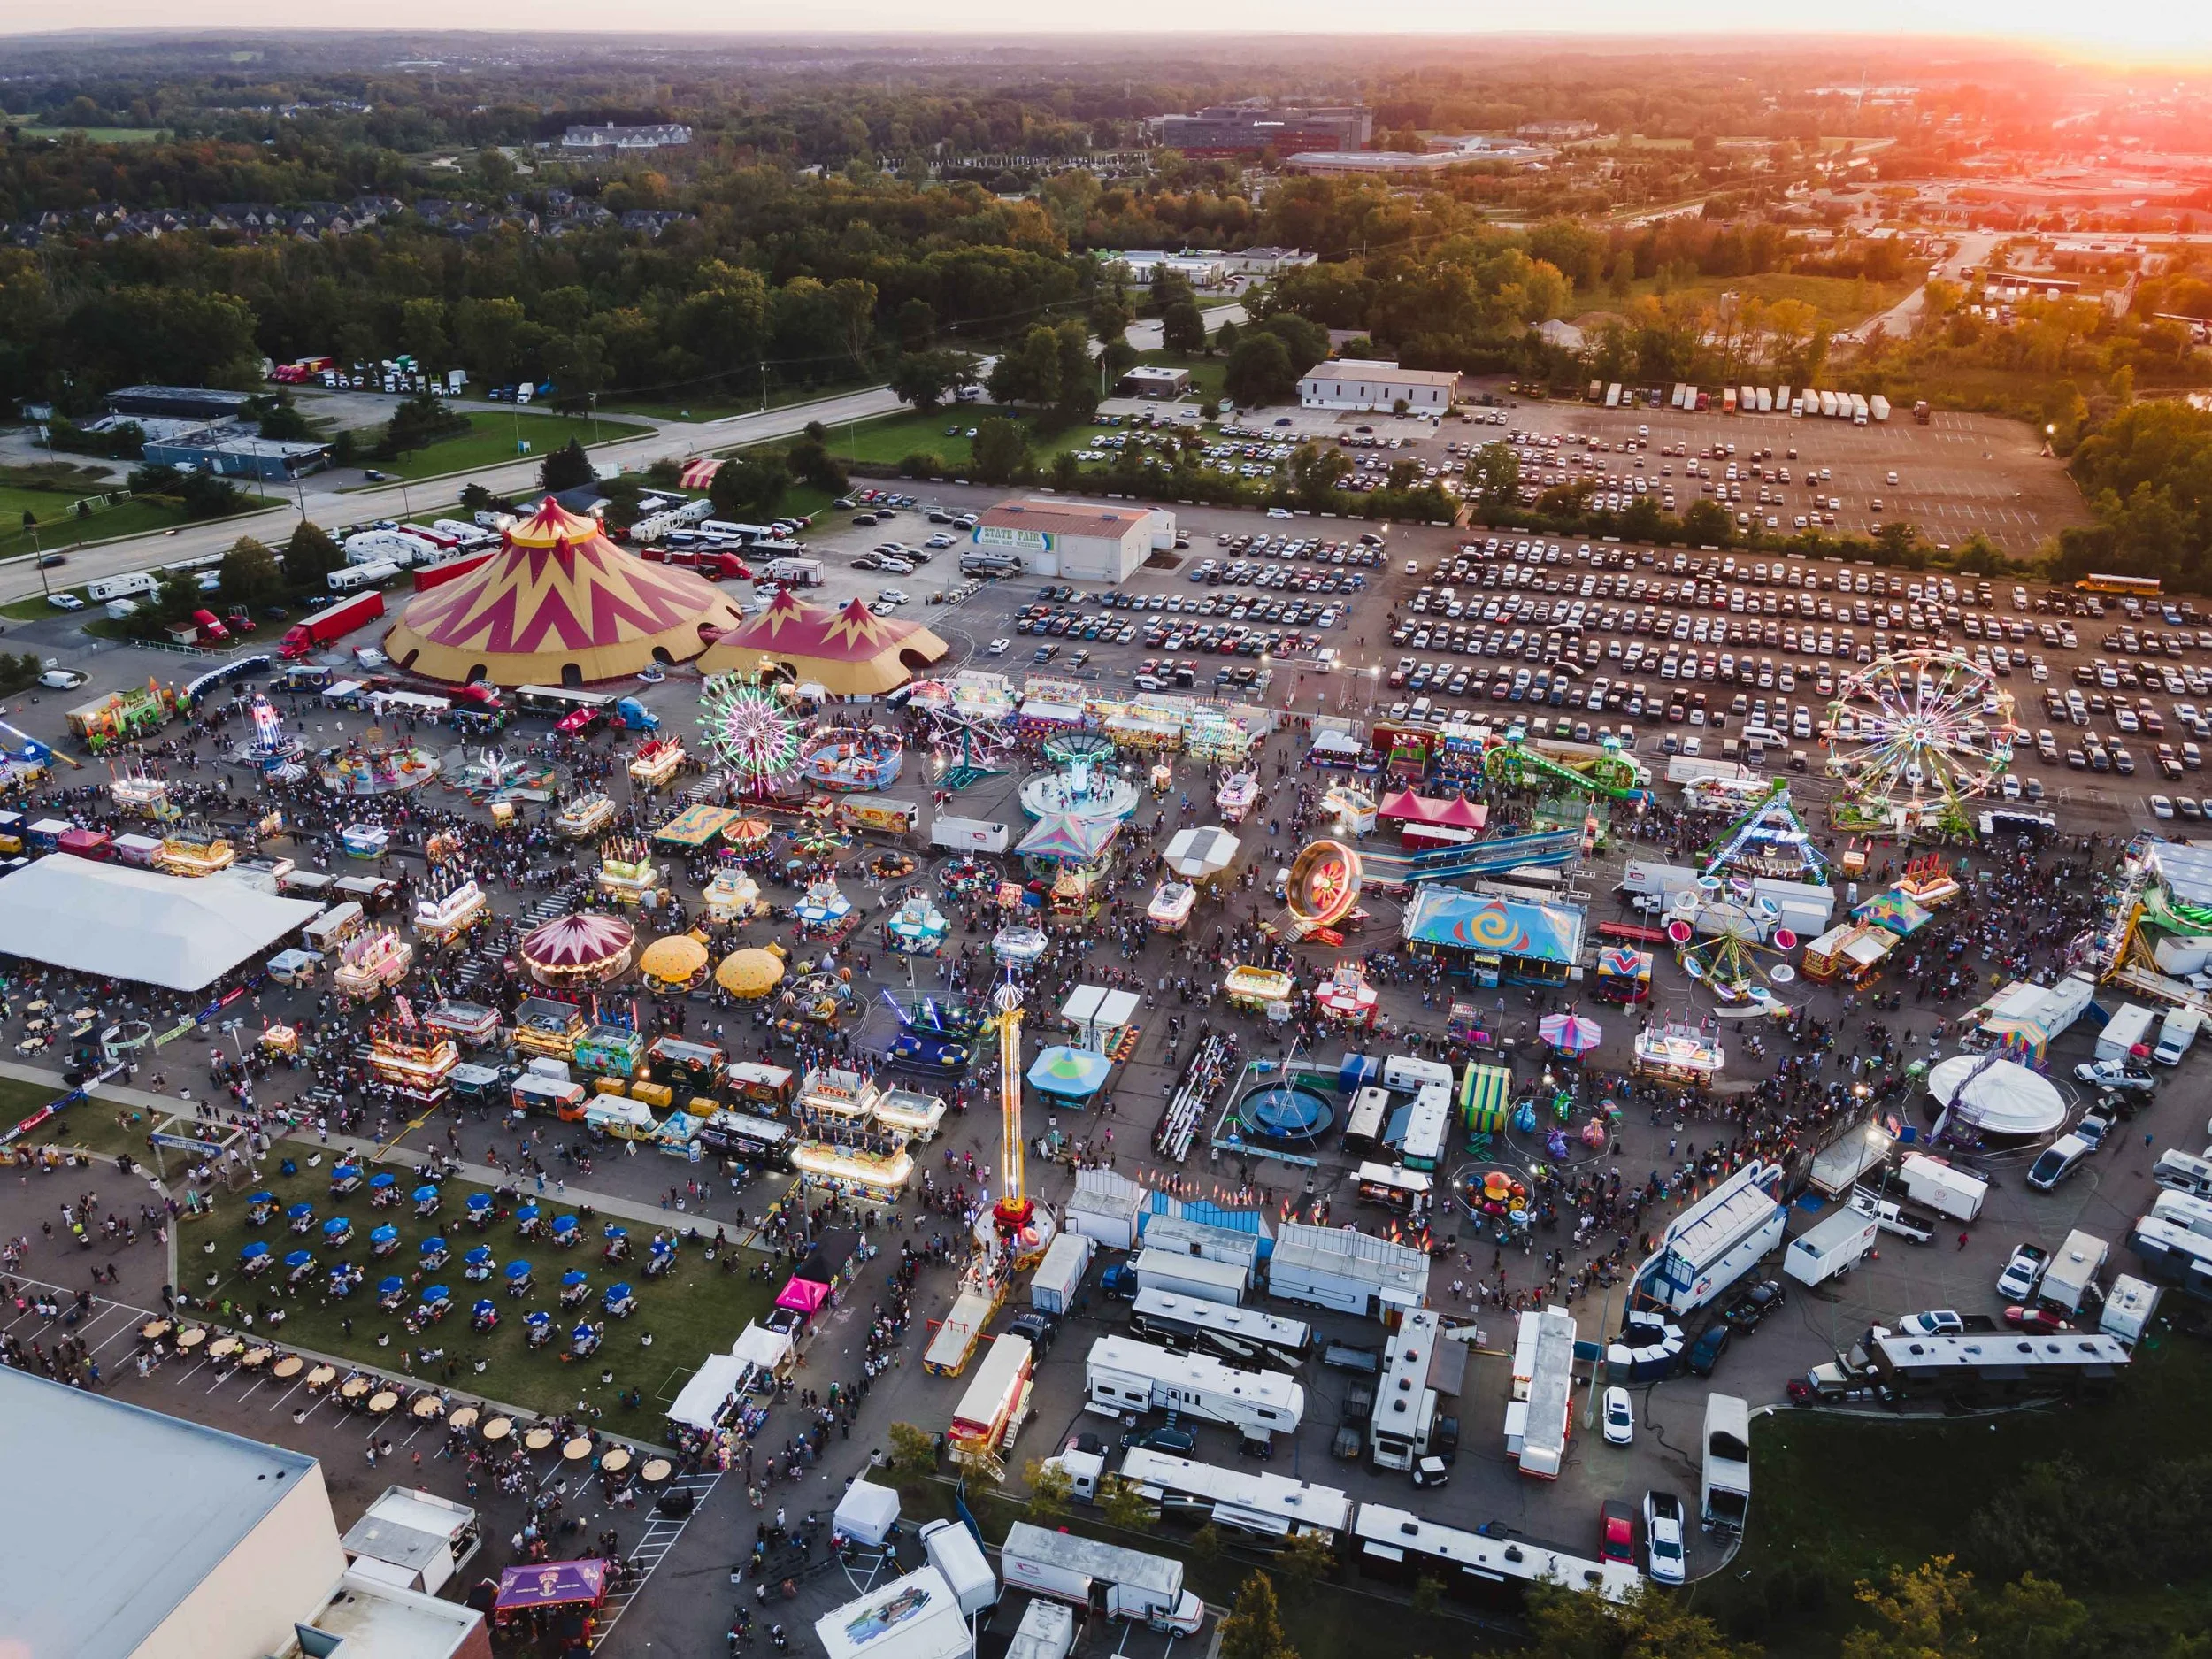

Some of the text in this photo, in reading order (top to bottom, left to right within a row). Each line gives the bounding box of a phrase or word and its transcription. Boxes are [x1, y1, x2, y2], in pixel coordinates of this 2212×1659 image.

[984, 527, 1041, 542] STATE FAIR
[818, 1086, 847, 1096] GYROS
[186, 1143, 204, 1153] STATE
